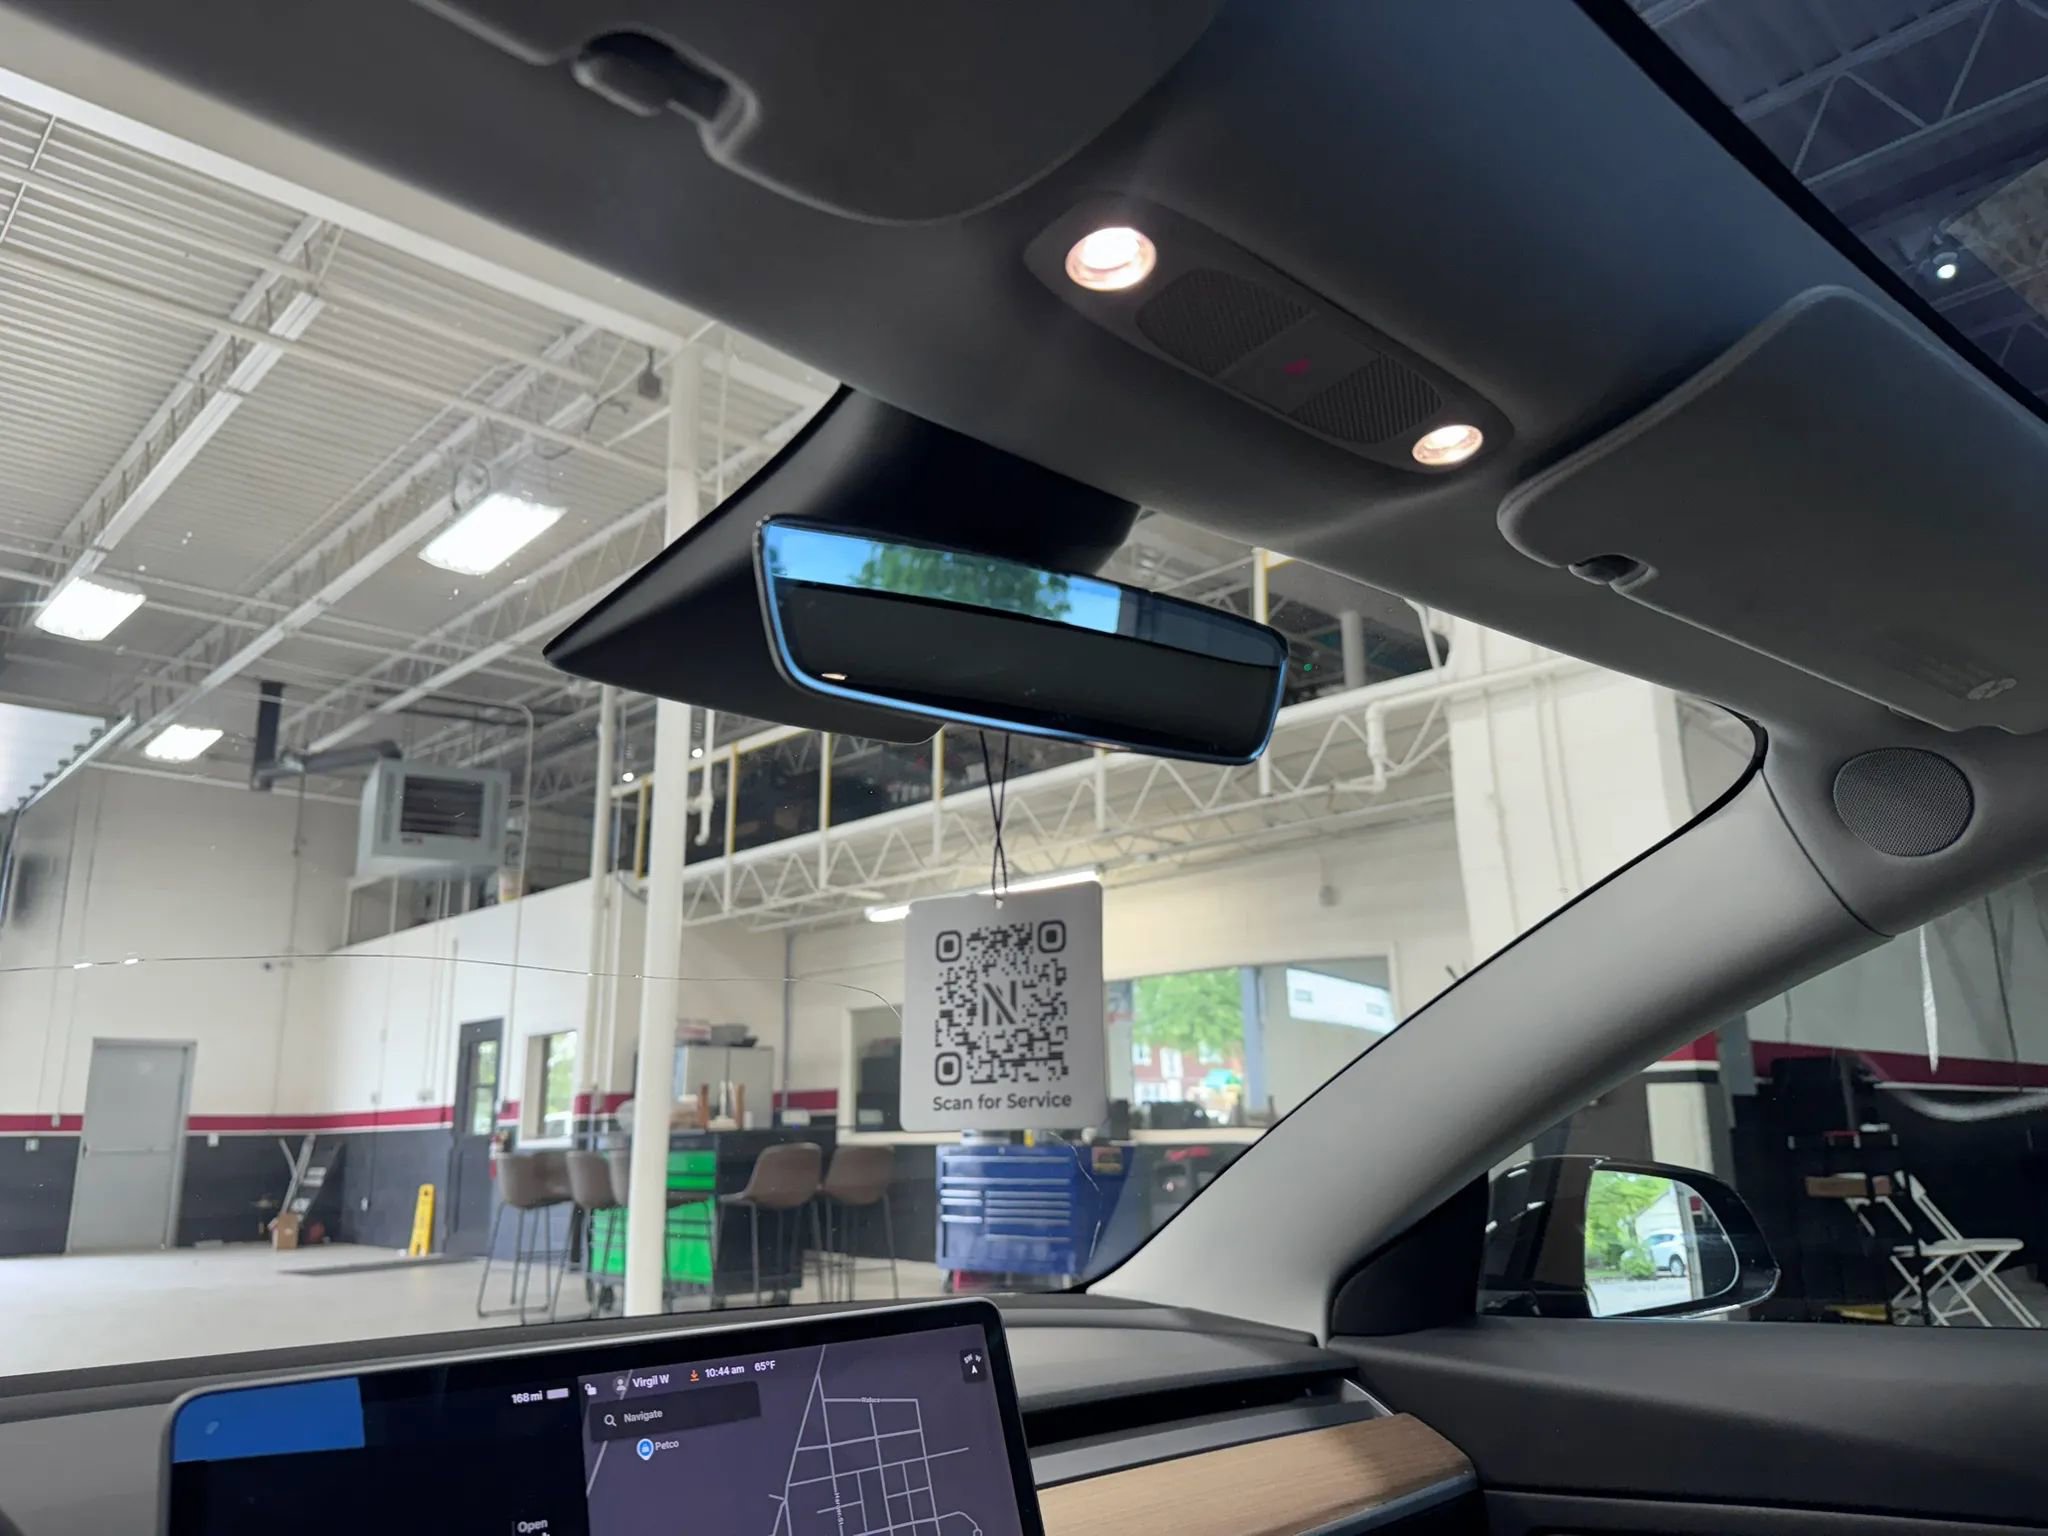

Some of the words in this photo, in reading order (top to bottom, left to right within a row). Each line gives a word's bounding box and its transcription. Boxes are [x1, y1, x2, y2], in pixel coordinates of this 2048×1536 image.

[933, 1096, 973, 1111] Scan
[978, 1092, 1002, 1110] for
[1006, 1090, 1073, 1109] Service
[705, 1366, 730, 1378] 10:44
[731, 1365, 745, 1375] am
[754, 1360, 776, 1372] 65°F
[632, 1374, 659, 1389] Virgil
[659, 1374, 670, 1384] W
[511, 1392, 530, 1404] 168
[530, 1390, 543, 1401] mi
[623, 1409, 663, 1424] Navigate
[655, 1439, 679, 1451] Petco
[517, 1519, 548, 1534] Open
